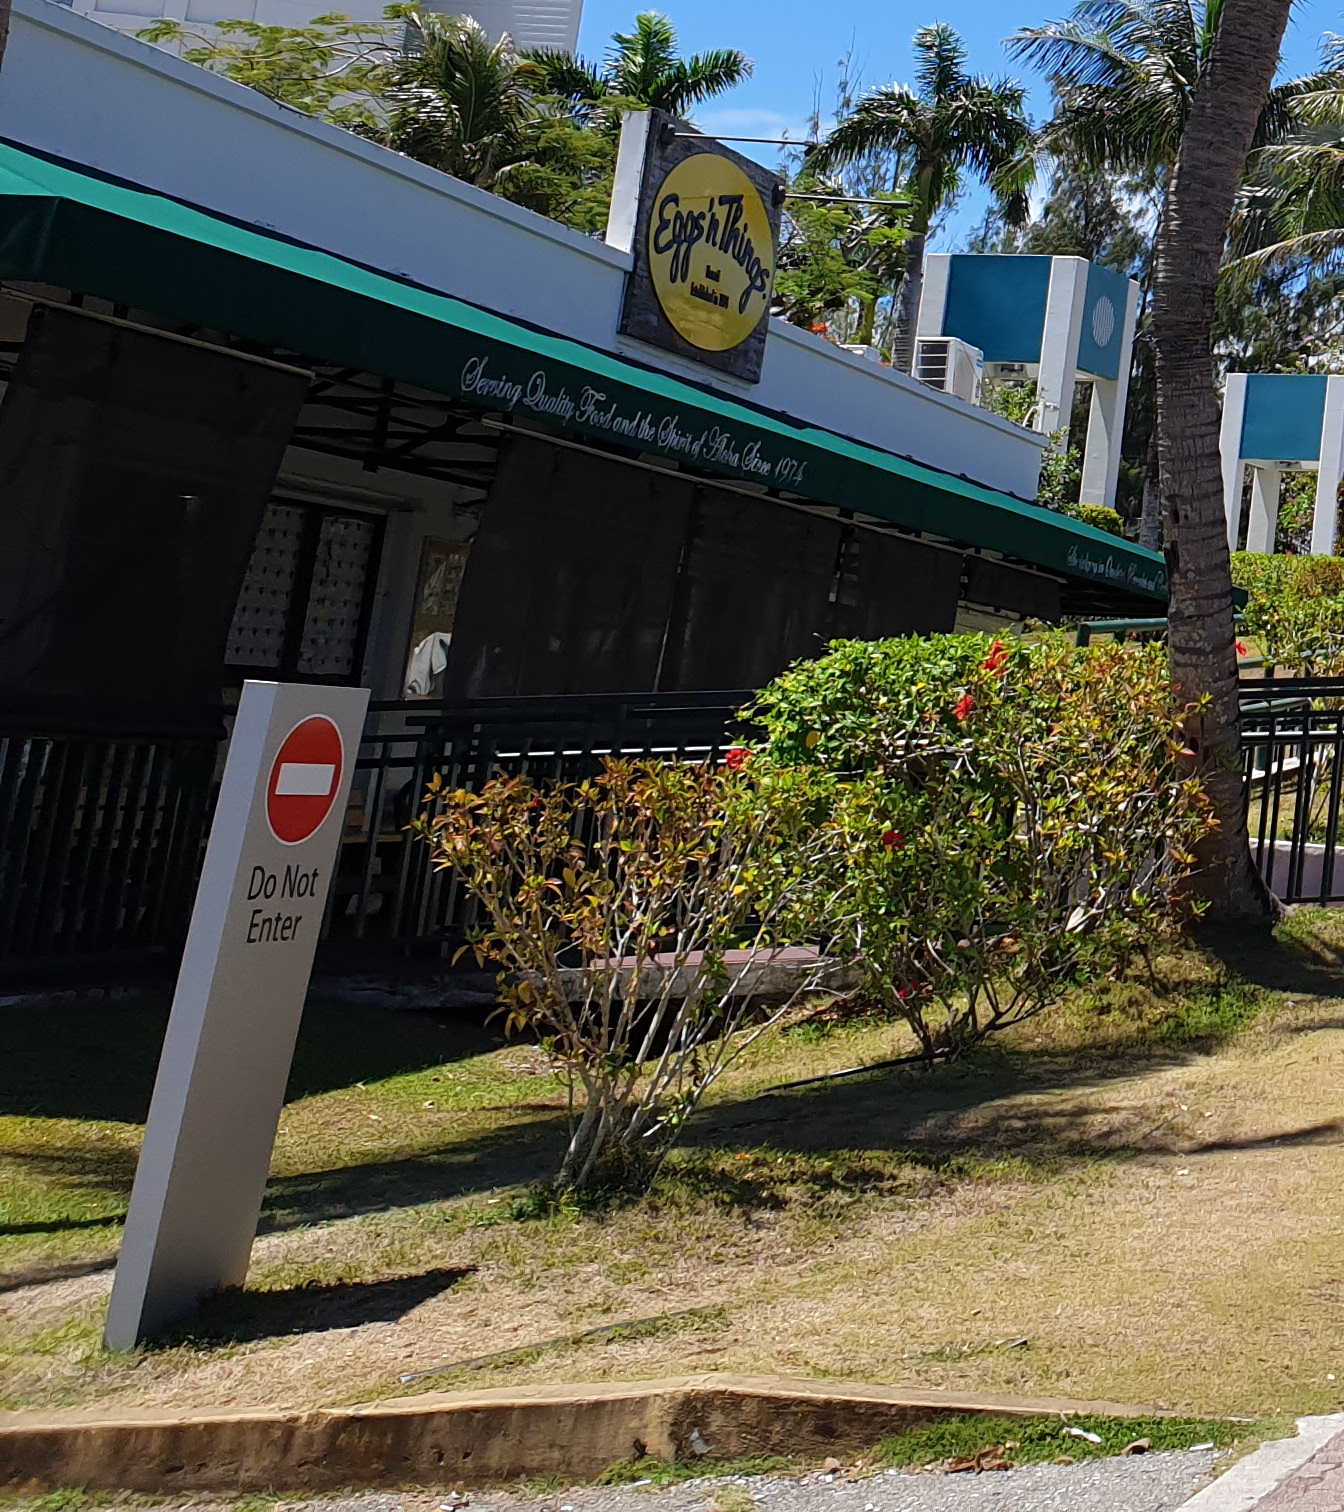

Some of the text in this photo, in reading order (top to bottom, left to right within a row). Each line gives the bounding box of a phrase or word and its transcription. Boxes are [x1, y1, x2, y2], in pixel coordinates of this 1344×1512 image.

[461, 356, 522, 411] Serving
[523, 371, 575, 427] Quality
[576, 386, 613, 430] Food
[613, 410, 638, 438] and
[637, 413, 655, 442] the
[658, 415, 693, 454] Spirit
[703, 426, 740, 467] Aloha
[774, 456, 808, 486] 1974
[247, 864, 319, 900] Do Not
[246, 909, 303, 943] Enter
